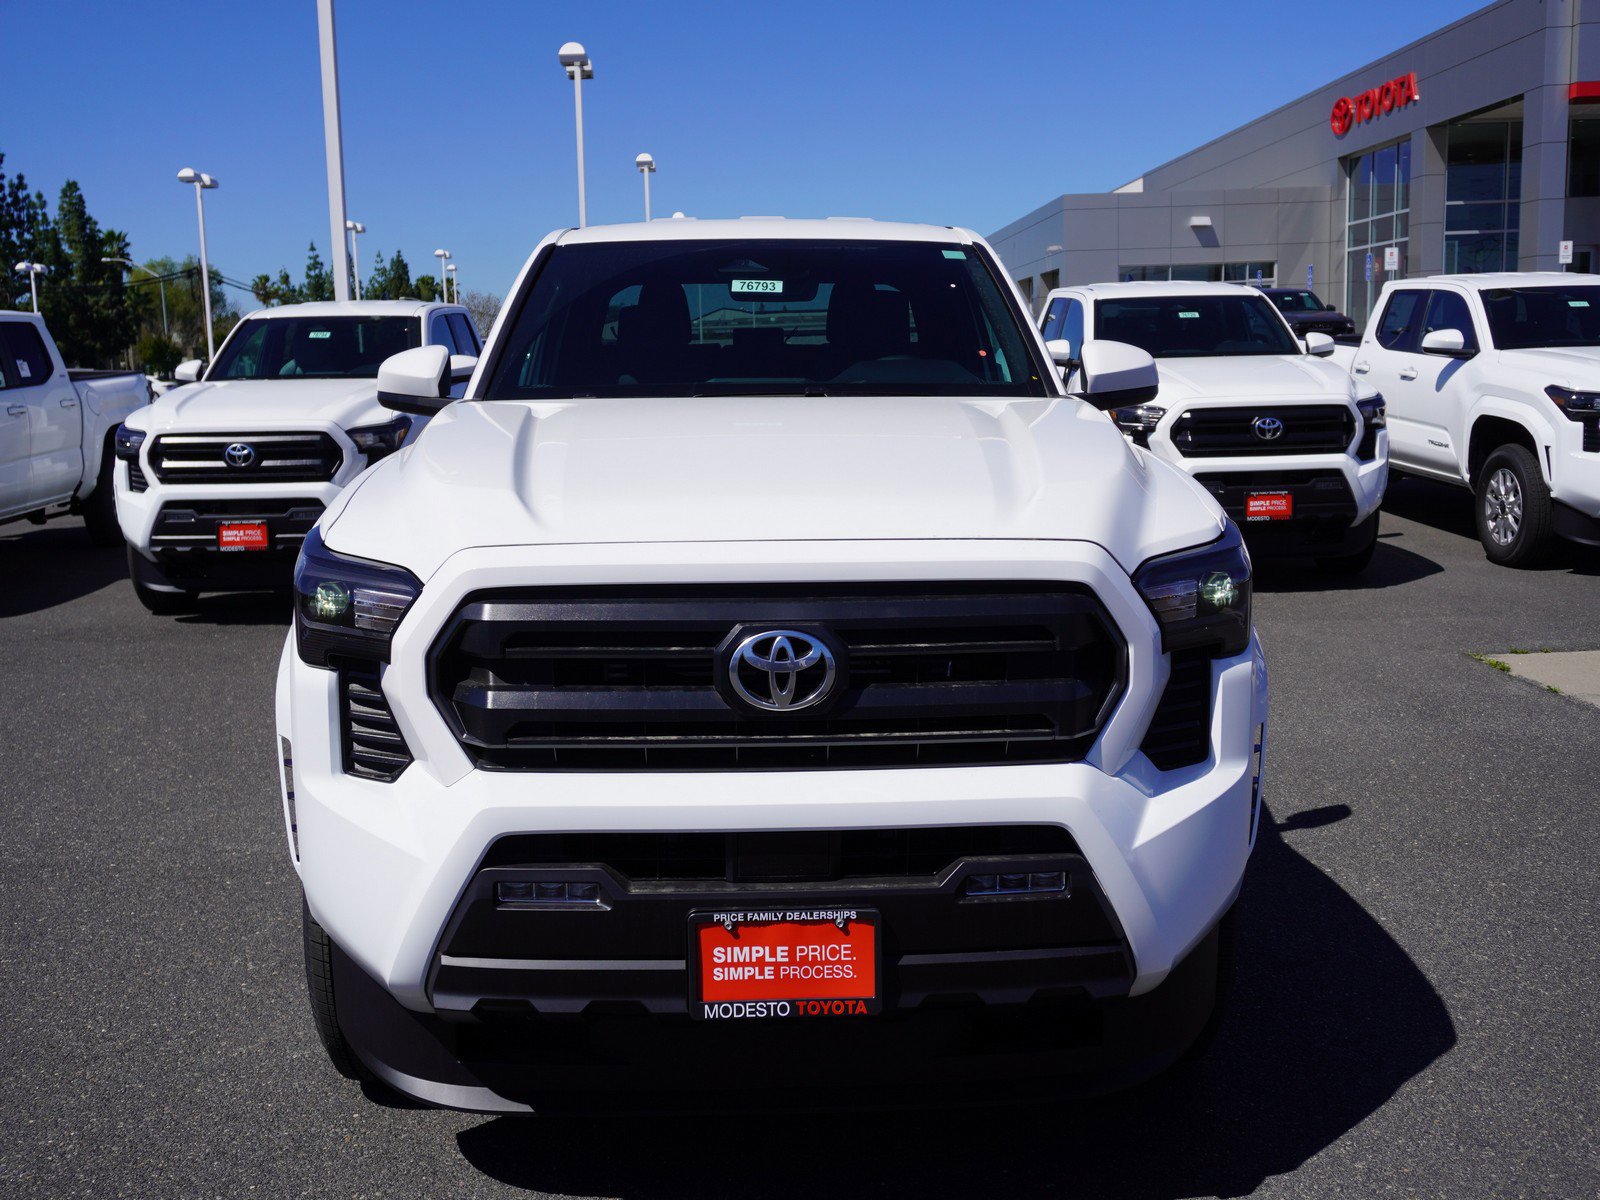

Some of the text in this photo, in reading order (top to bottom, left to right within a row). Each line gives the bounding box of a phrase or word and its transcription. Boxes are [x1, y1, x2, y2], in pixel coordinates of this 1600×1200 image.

[1353, 72, 1417, 125] TOYOTA
[739, 281, 776, 291] 76793
[713, 911, 857, 922] PRICE FAMILY DEALERSHIPS
[713, 944, 857, 963] SIMPLE PRICE.
[713, 965, 857, 981] SIMPLE PROCESS.
[704, 1001, 867, 1018] MODESTO TOYOTA
